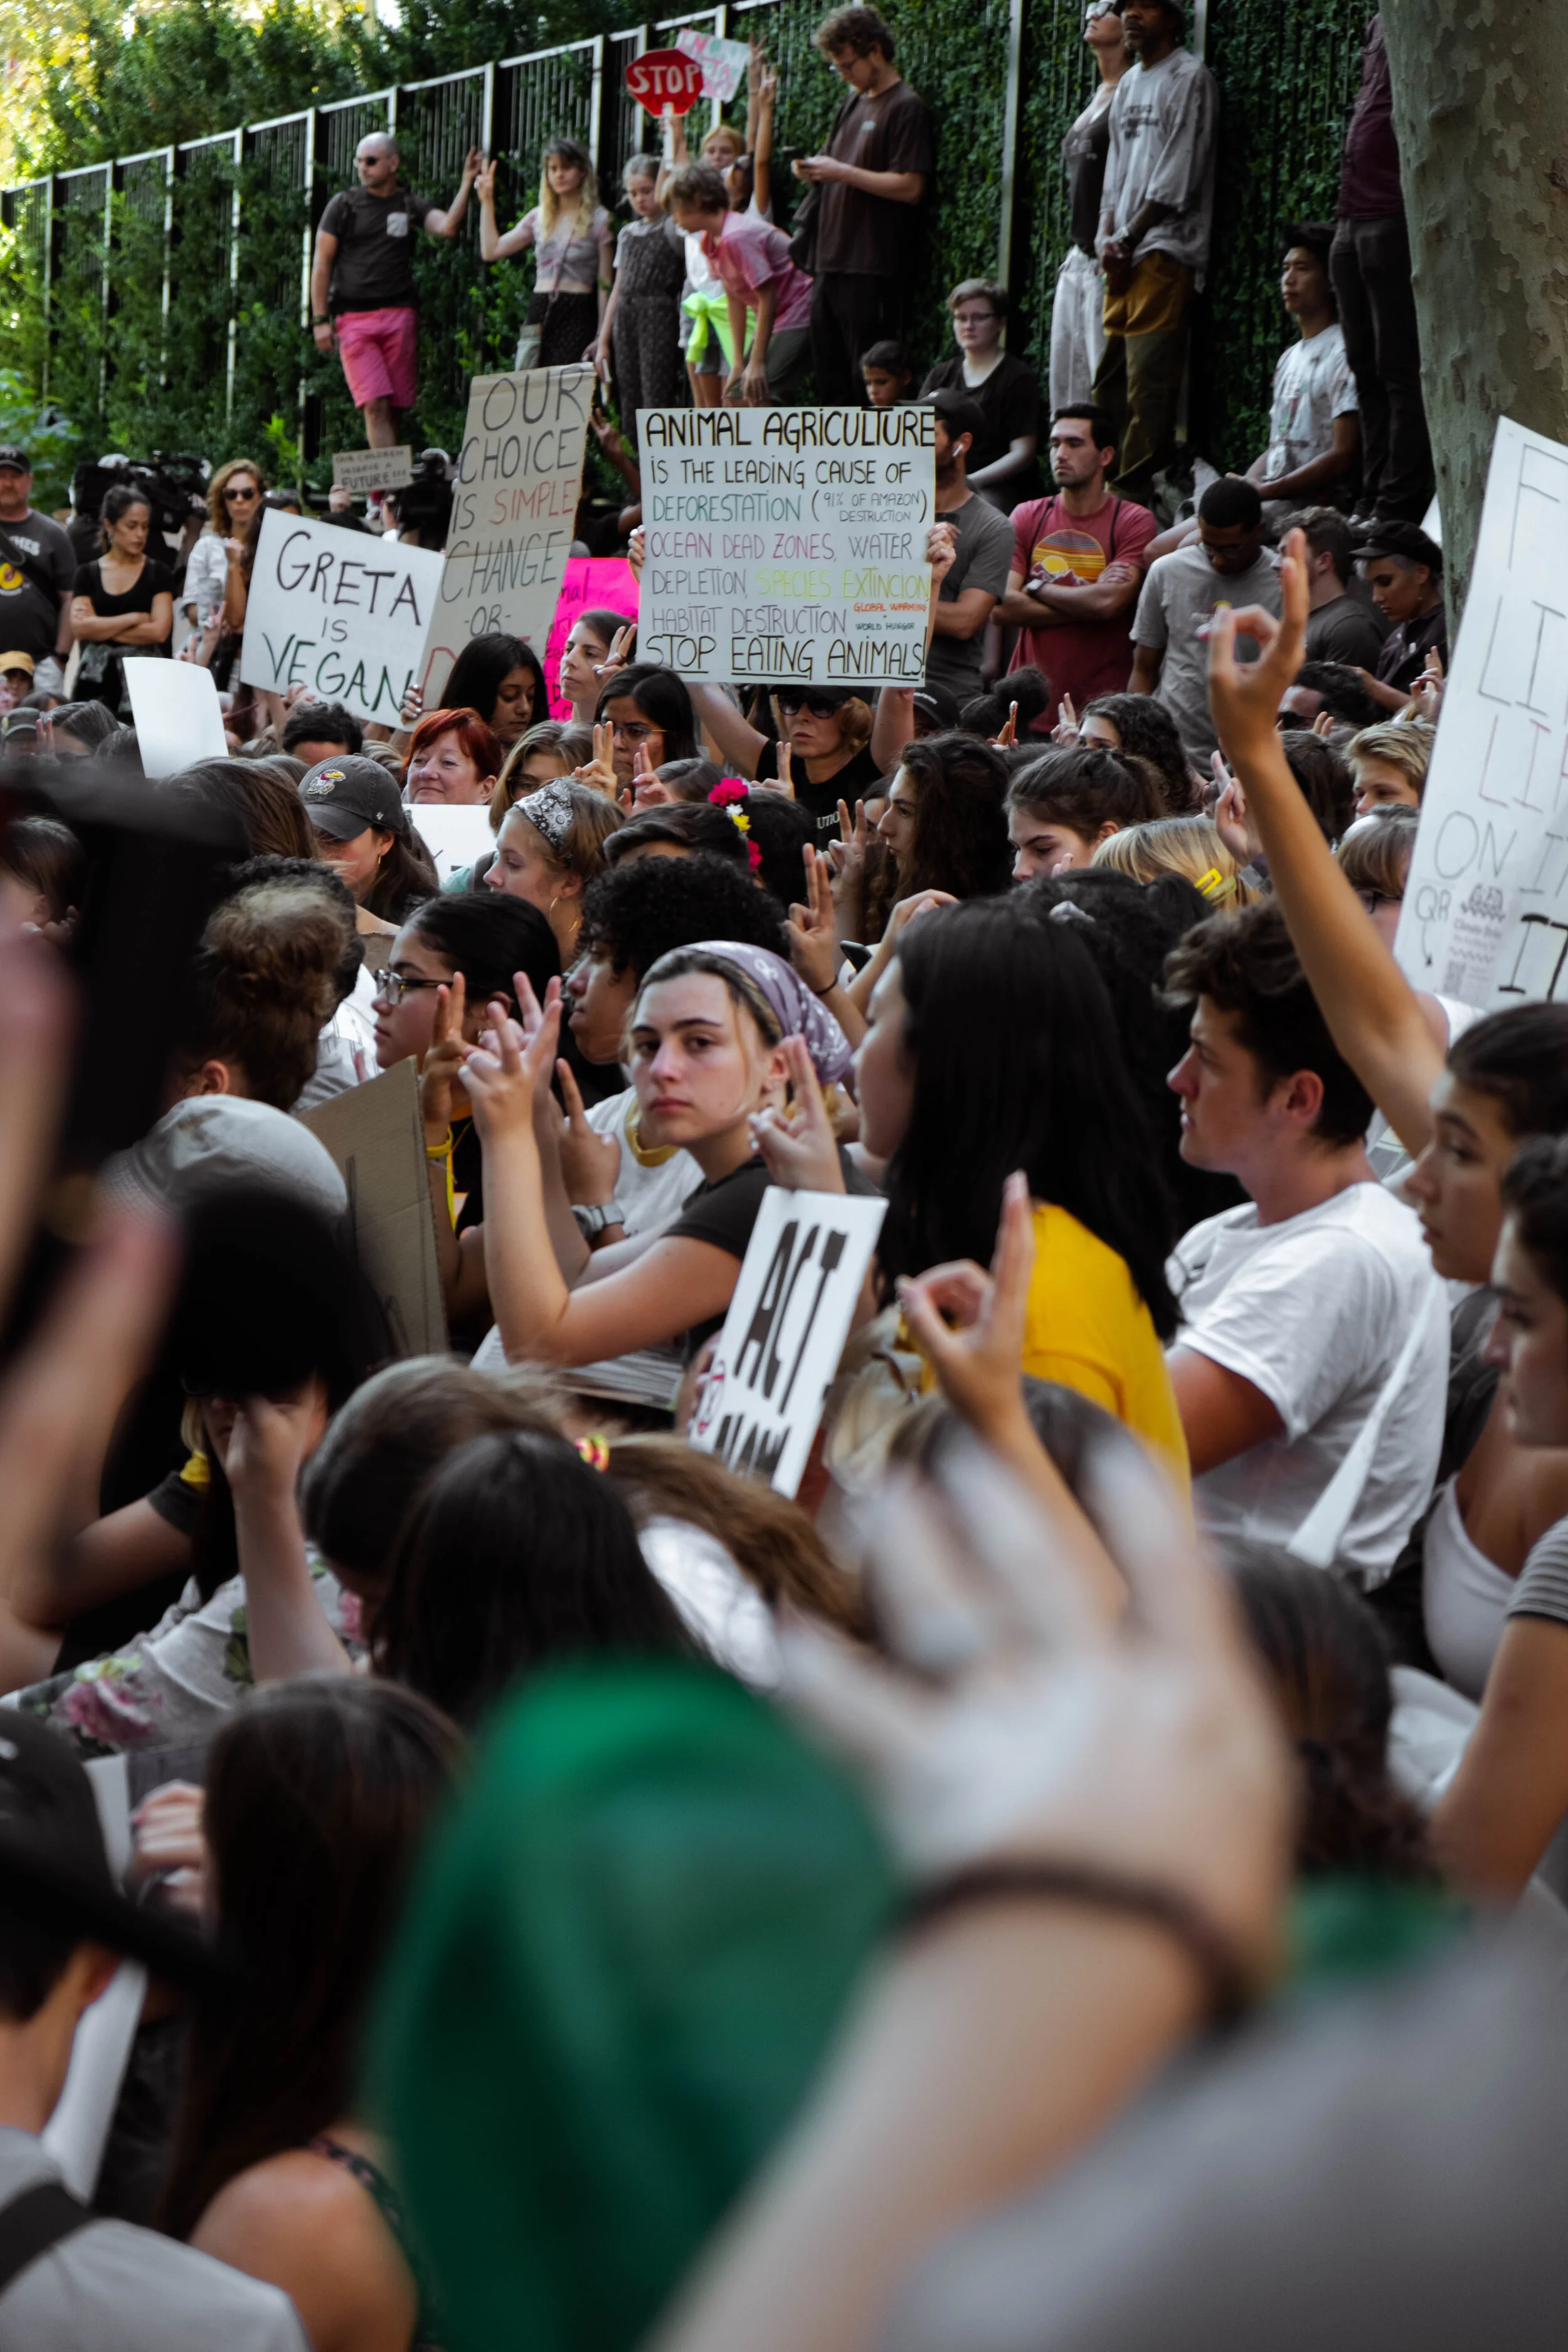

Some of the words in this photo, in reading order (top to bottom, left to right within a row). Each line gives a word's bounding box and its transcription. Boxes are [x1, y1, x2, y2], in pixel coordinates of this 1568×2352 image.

[627, 64, 701, 94] STOP
[483, 368, 586, 432] OUR
[646, 410, 752, 447] ANIMAL
[763, 406, 935, 453] AGRICULTURE
[459, 426, 580, 485] CHOICE
[650, 455, 669, 484] IS
[681, 458, 715, 484] THE
[725, 454, 805, 489] LEADING
[815, 460, 876, 484] CAUSE
[886, 462, 912, 484] OF
[452, 492, 477, 534] IS
[489, 480, 577, 525] SIMPLE
[652, 489, 802, 522] DEFORESTATION
[852, 493, 867, 507] OF
[839, 510, 911, 522] DESTRUCTION
[441, 530, 564, 603] CHANGE
[650, 532, 712, 559] OCEAN
[723, 534, 765, 559] DEAD
[773, 532, 837, 562] ZONES,
[848, 532, 913, 560] WATER
[277, 531, 422, 626] GRETA
[652, 566, 748, 599] DEPLETION,
[756, 567, 832, 598] SPECIES
[652, 602, 723, 632] HABITAT
[854, 602, 886, 613] GLOBAL
[889, 602, 926, 613] WARMING
[856, 622, 882, 631] WORLD
[886, 622, 915, 631] HUNGER
[321, 617, 348, 643] IS
[262, 632, 414, 712] VEGAN
[646, 633, 717, 669] STOP
[732, 634, 814, 680] EATING
[827, 626, 928, 679] ANIMALS!
[1434, 810, 1517, 879] ON
[1414, 884, 1452, 923] QR
[733, 1220, 848, 1417] ACT
